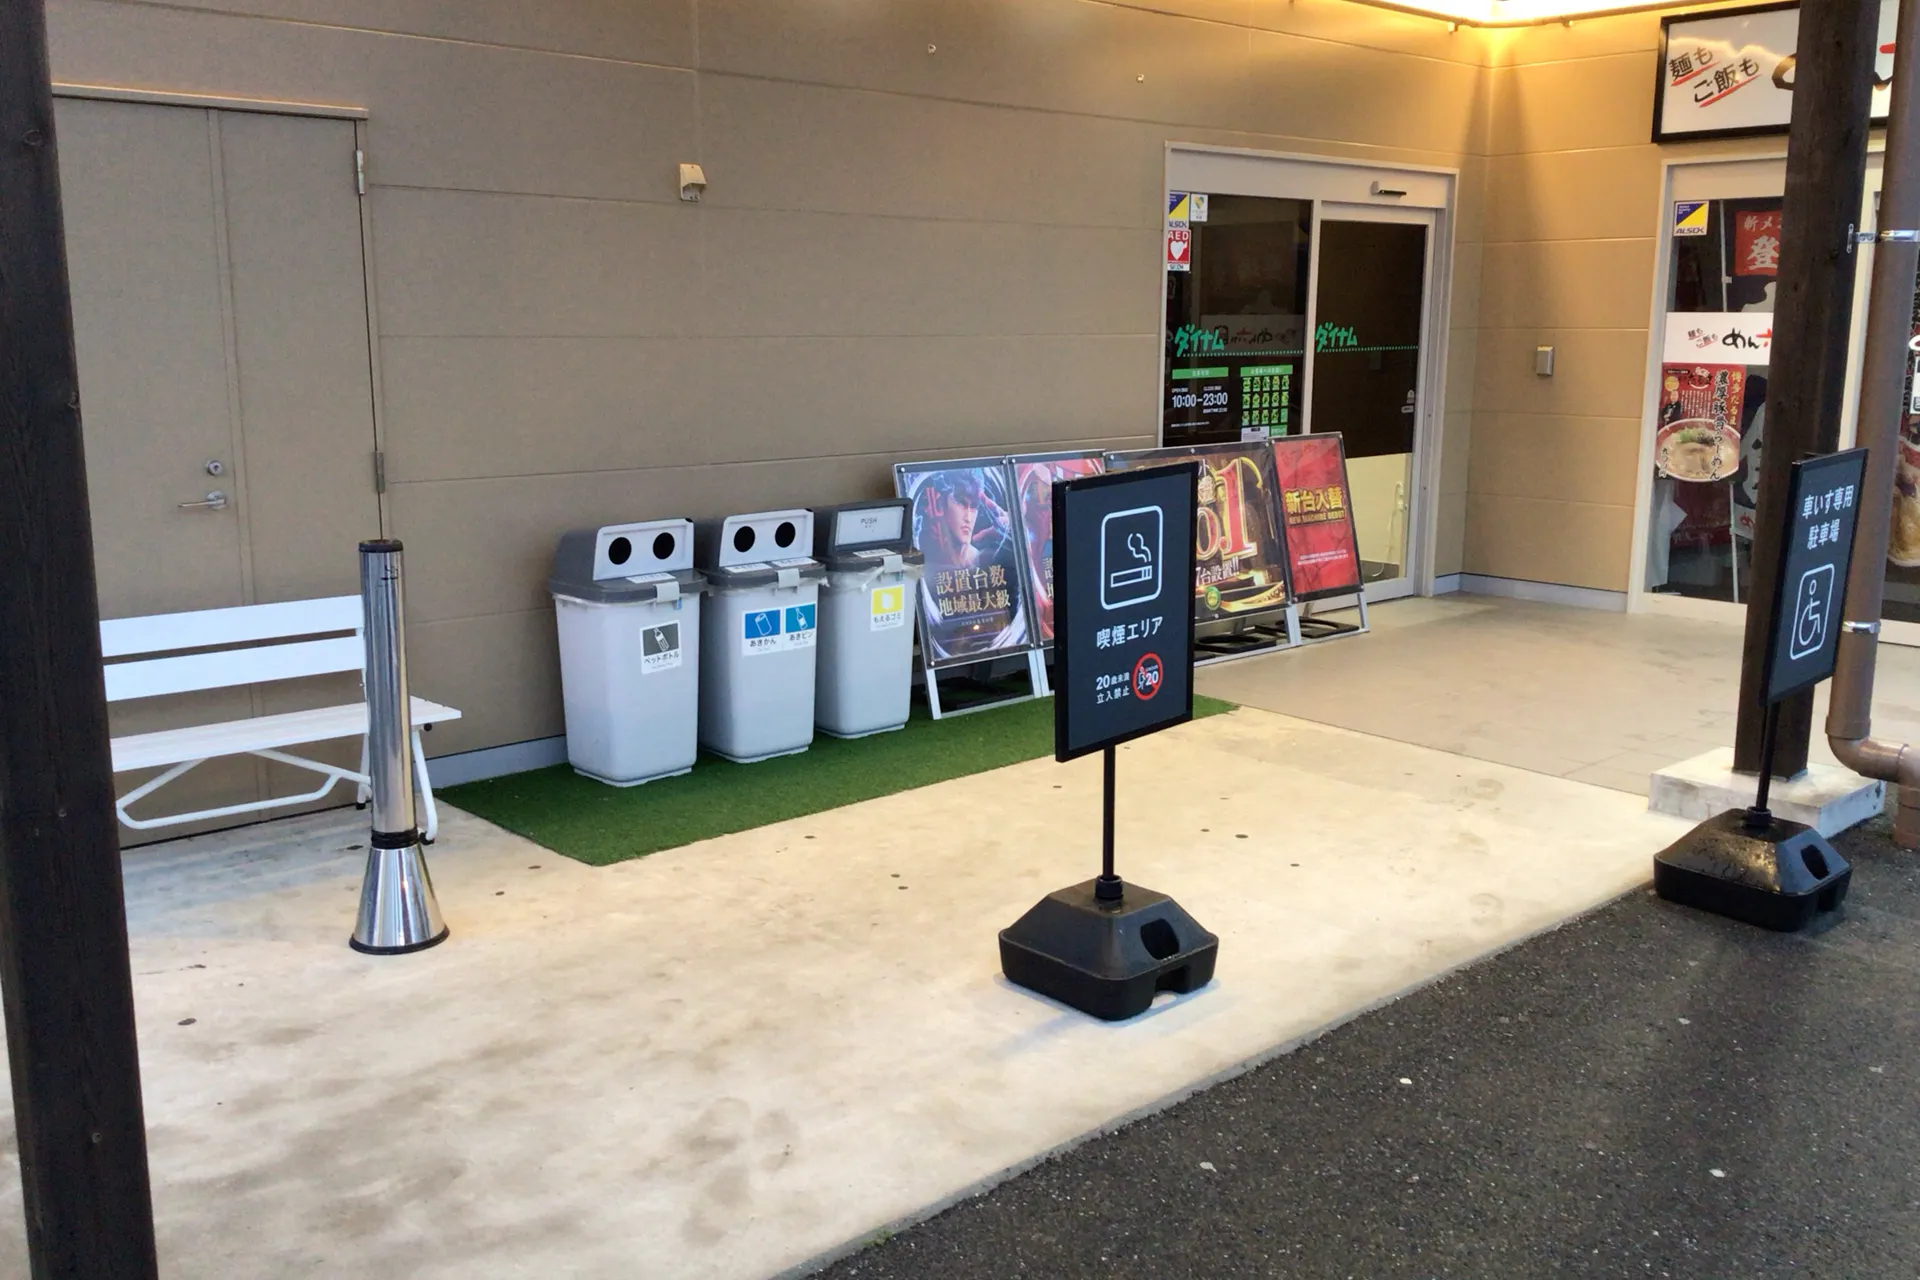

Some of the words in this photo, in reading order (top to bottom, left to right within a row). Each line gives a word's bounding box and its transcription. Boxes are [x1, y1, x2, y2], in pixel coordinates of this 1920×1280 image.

[1669, 47, 1713, 81] 麺も
[1693, 58, 1760, 102] ご飯も
[1168, 231, 1189, 240] AED
[1744, 215, 1782, 231] 新メ
[1175, 324, 1225, 357] ダイナム
[1315, 322, 1358, 353] ダイナム
[1284, 486, 1343, 514] 新台入替
[1802, 485, 1854, 519] 車いす専用
[1807, 519, 1840, 550] 駐車場
[936, 565, 1007, 595] 設置台数
[938, 589, 1011, 617] 地域最大級
[750, 638, 776, 647] あきかん
[1096, 616, 1163, 650] 喫煙エリア
[644, 652, 680, 664] ペットボトル
[1096, 672, 1130, 691] 20歳未満
[1145, 671, 1159, 687] 20
[1096, 685, 1130, 704] 立入禁止
